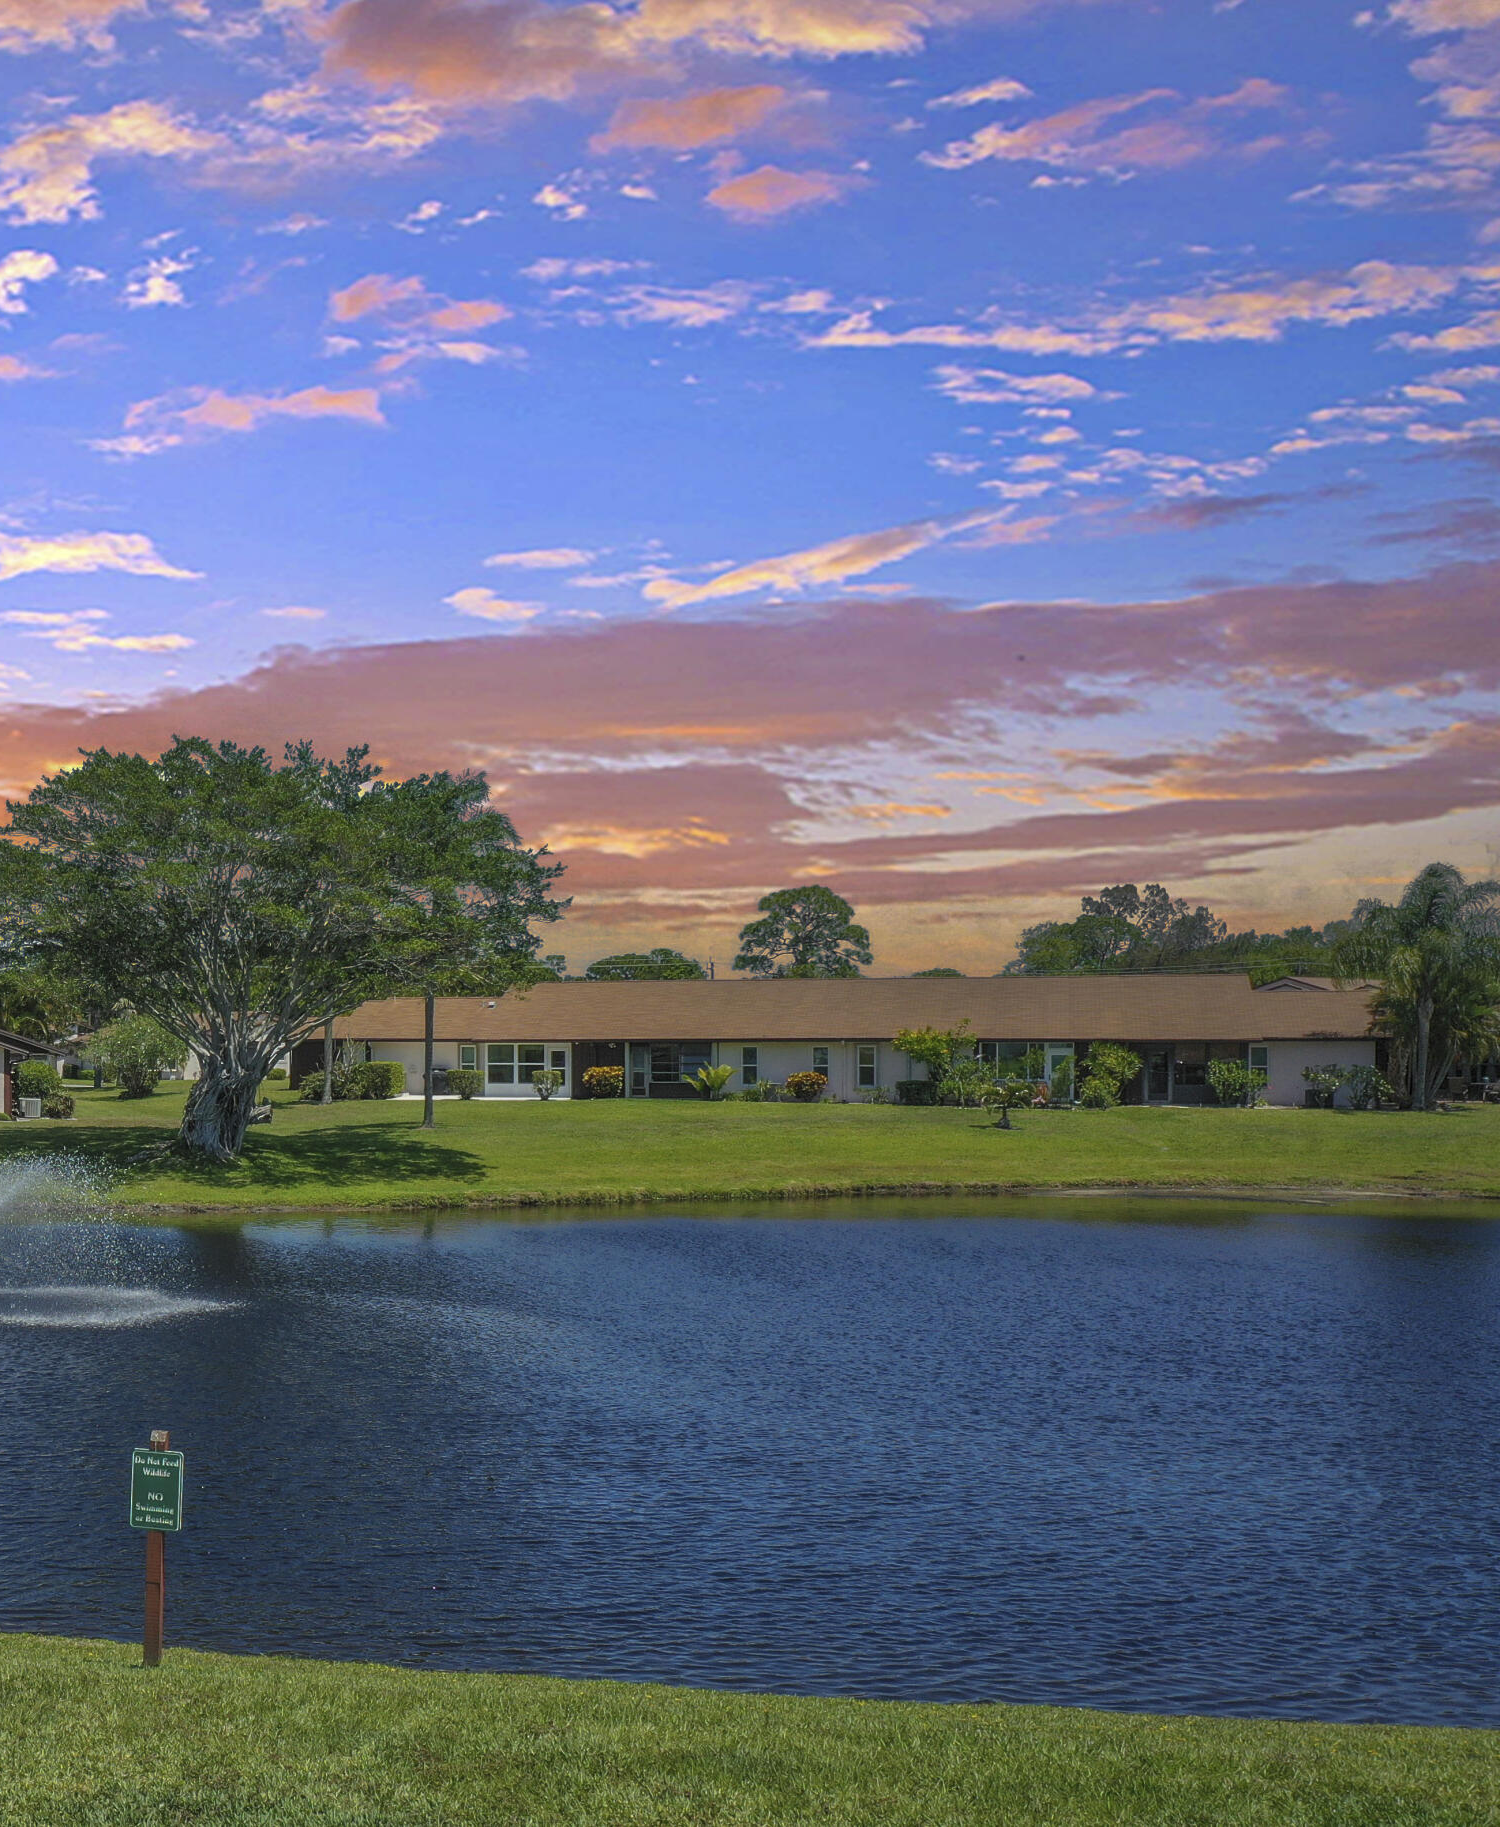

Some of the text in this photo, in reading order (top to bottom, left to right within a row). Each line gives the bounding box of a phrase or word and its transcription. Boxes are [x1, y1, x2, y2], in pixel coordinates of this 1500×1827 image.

[135, 1455, 179, 1467] Do Not Feed
[143, 1467, 171, 1477] Wildlife
[147, 1492, 164, 1501] NO
[135, 1502, 174, 1515] Swimming
